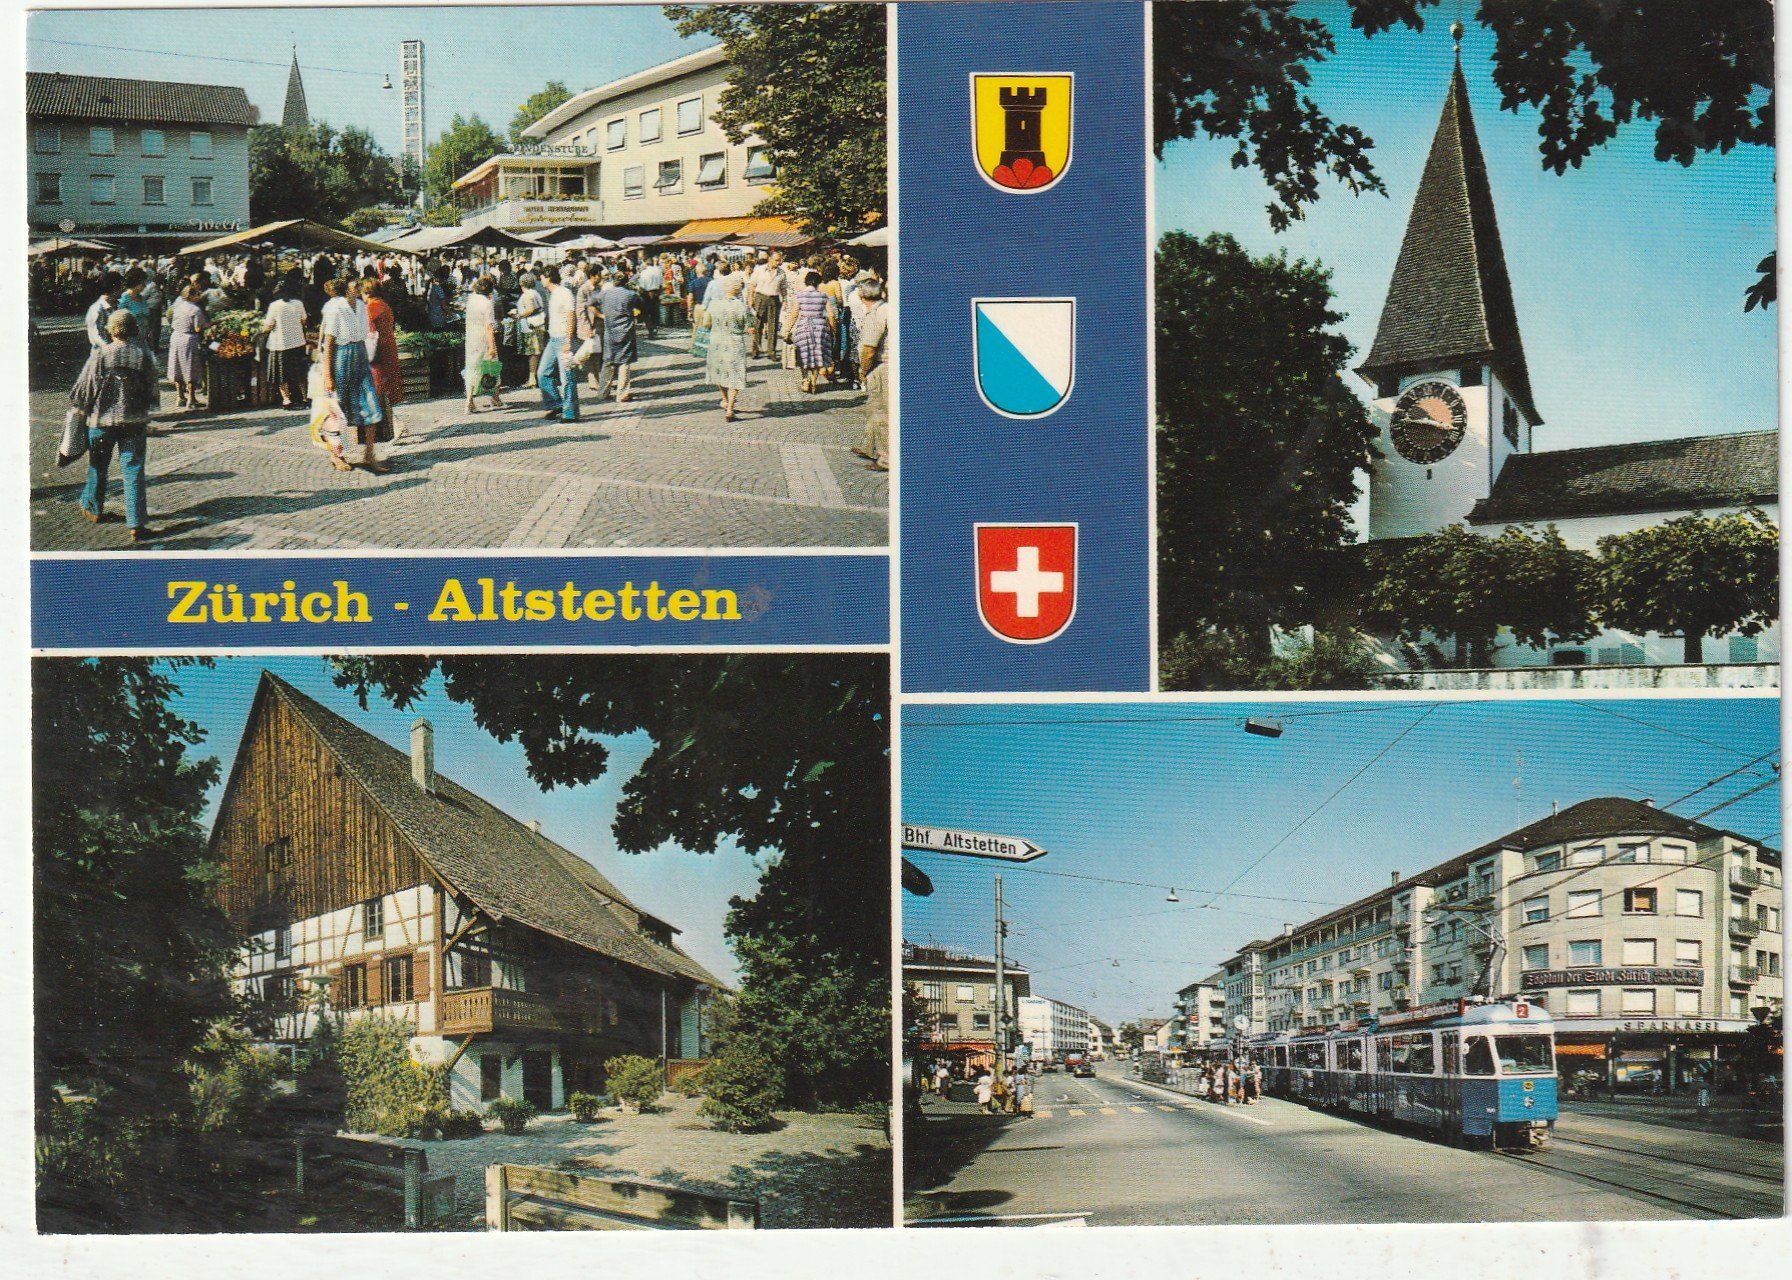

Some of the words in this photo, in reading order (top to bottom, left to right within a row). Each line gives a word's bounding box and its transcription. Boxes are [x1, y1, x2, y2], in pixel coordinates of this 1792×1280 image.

[904, 827, 933, 845] Bhf.
[943, 832, 1018, 855] Altstetten
[1518, 1005, 1526, 1017] 2
[1624, 1021, 1719, 1031] SPARKASSE
